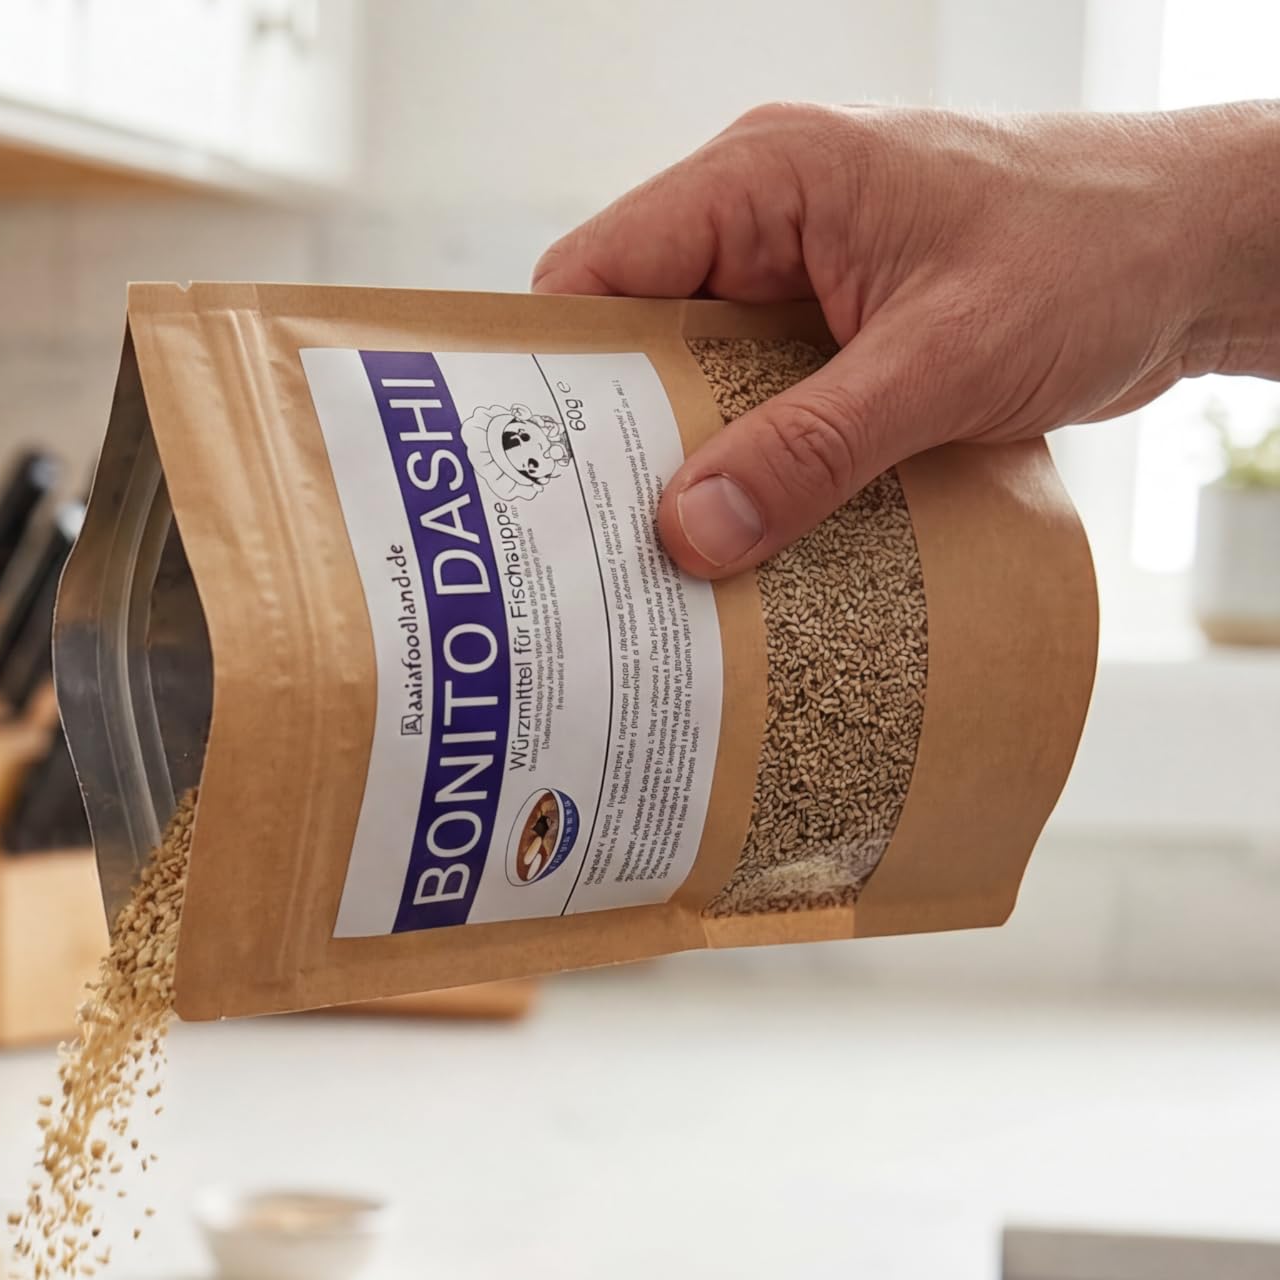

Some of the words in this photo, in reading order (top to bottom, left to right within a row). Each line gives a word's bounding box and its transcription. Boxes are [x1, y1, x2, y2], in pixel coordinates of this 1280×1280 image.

[380, 377, 498, 597] DASHI
[565, 399, 586, 431] 60g
[413, 621, 499, 906] BONITO
